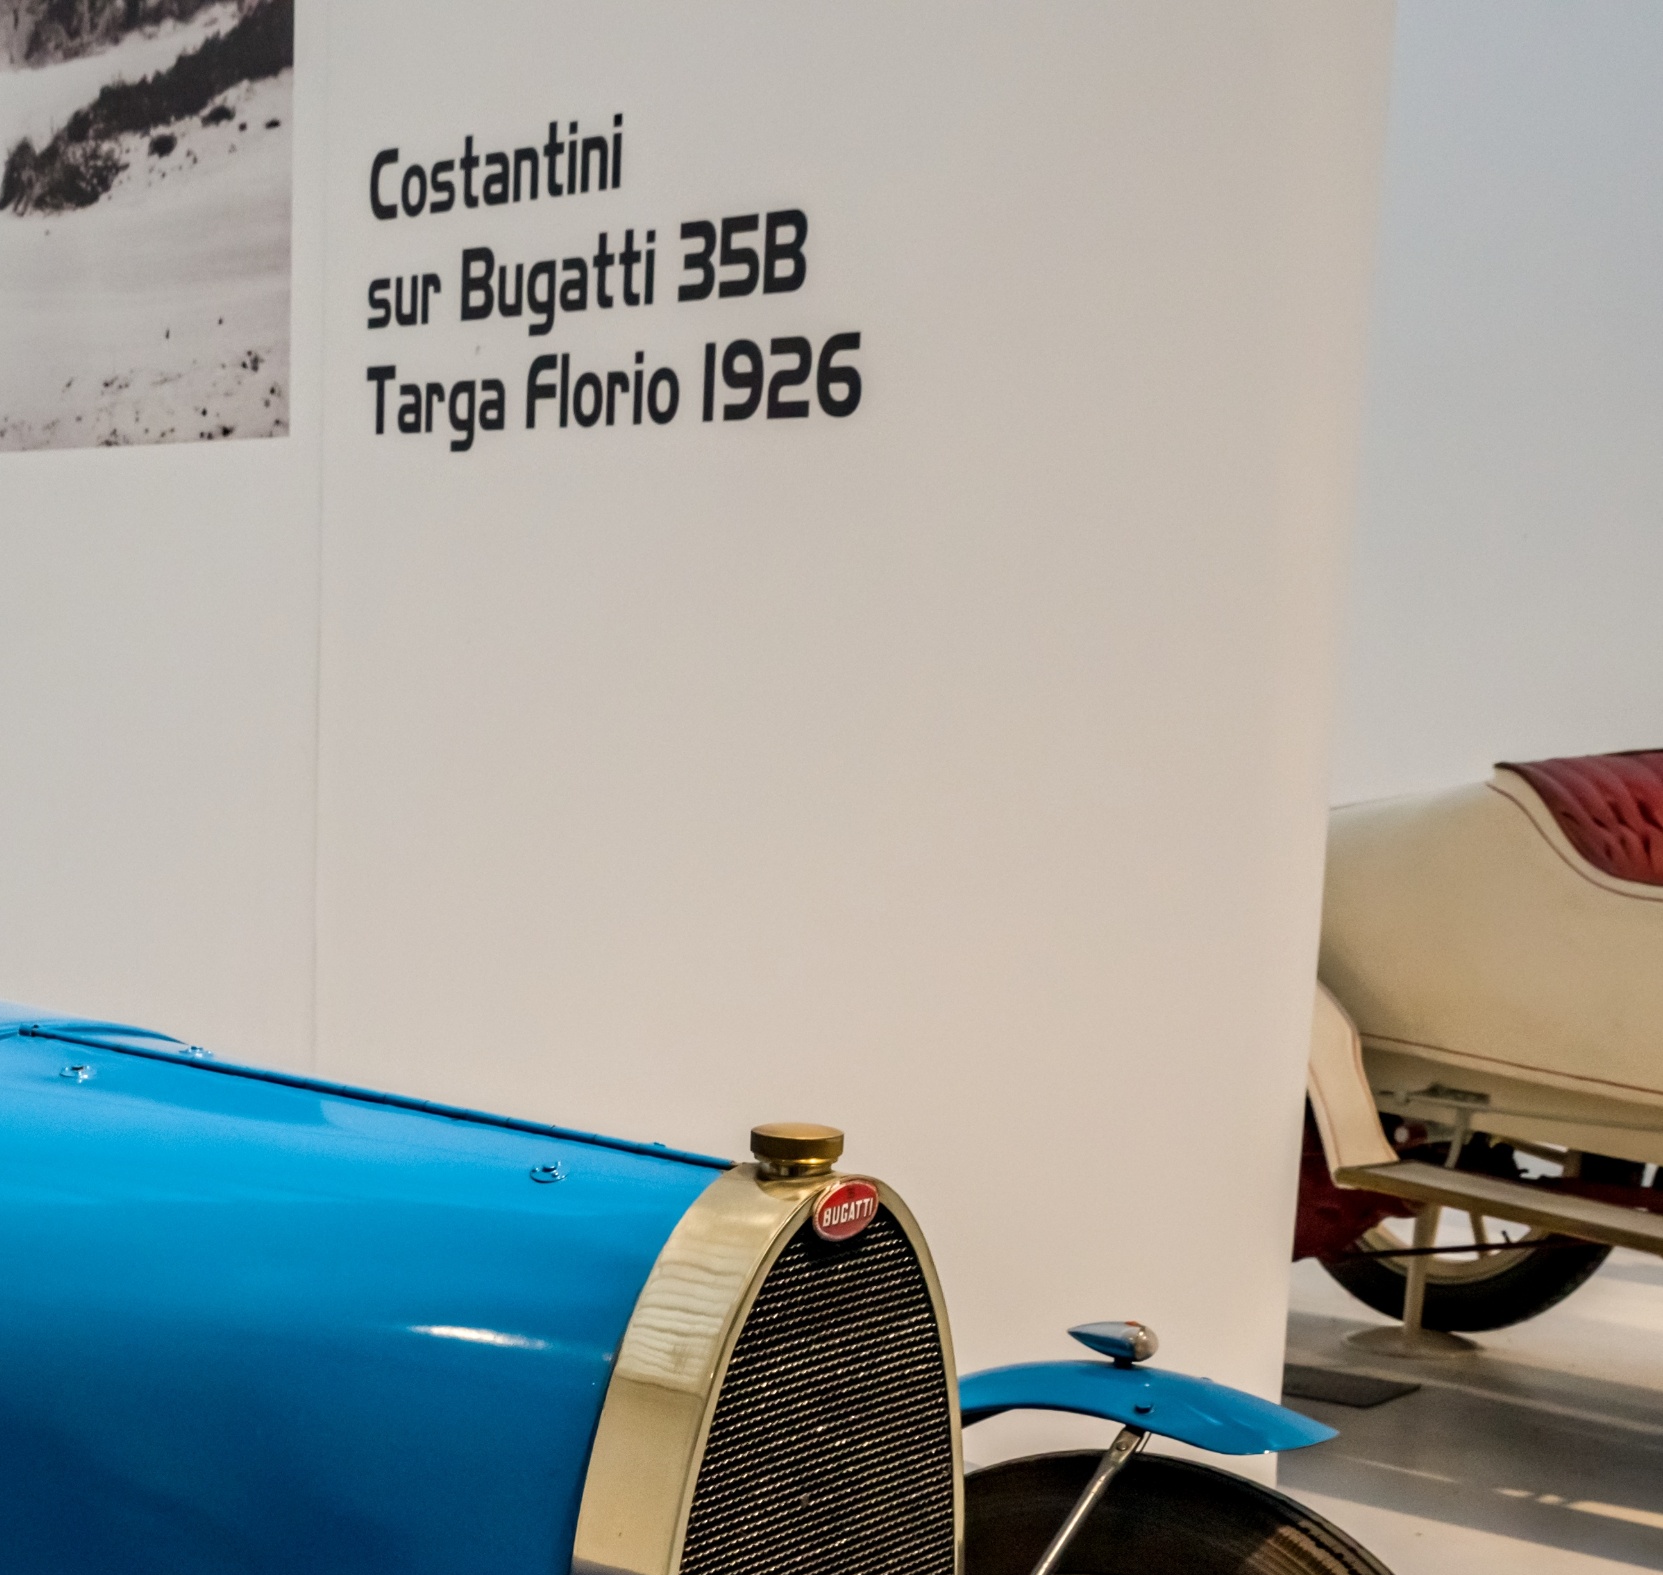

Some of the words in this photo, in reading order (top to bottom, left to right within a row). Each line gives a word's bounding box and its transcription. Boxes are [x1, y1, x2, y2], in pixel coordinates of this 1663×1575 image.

[370, 113, 623, 220] Costantini
[367, 273, 441, 329] sur
[460, 229, 656, 336] Bugatti
[677, 209, 808, 302] 35B
[366, 365, 506, 452] Targa
[525, 351, 680, 430] Florio
[702, 332, 863, 423] 1926
[822, 1198, 874, 1227] BUGATTI
